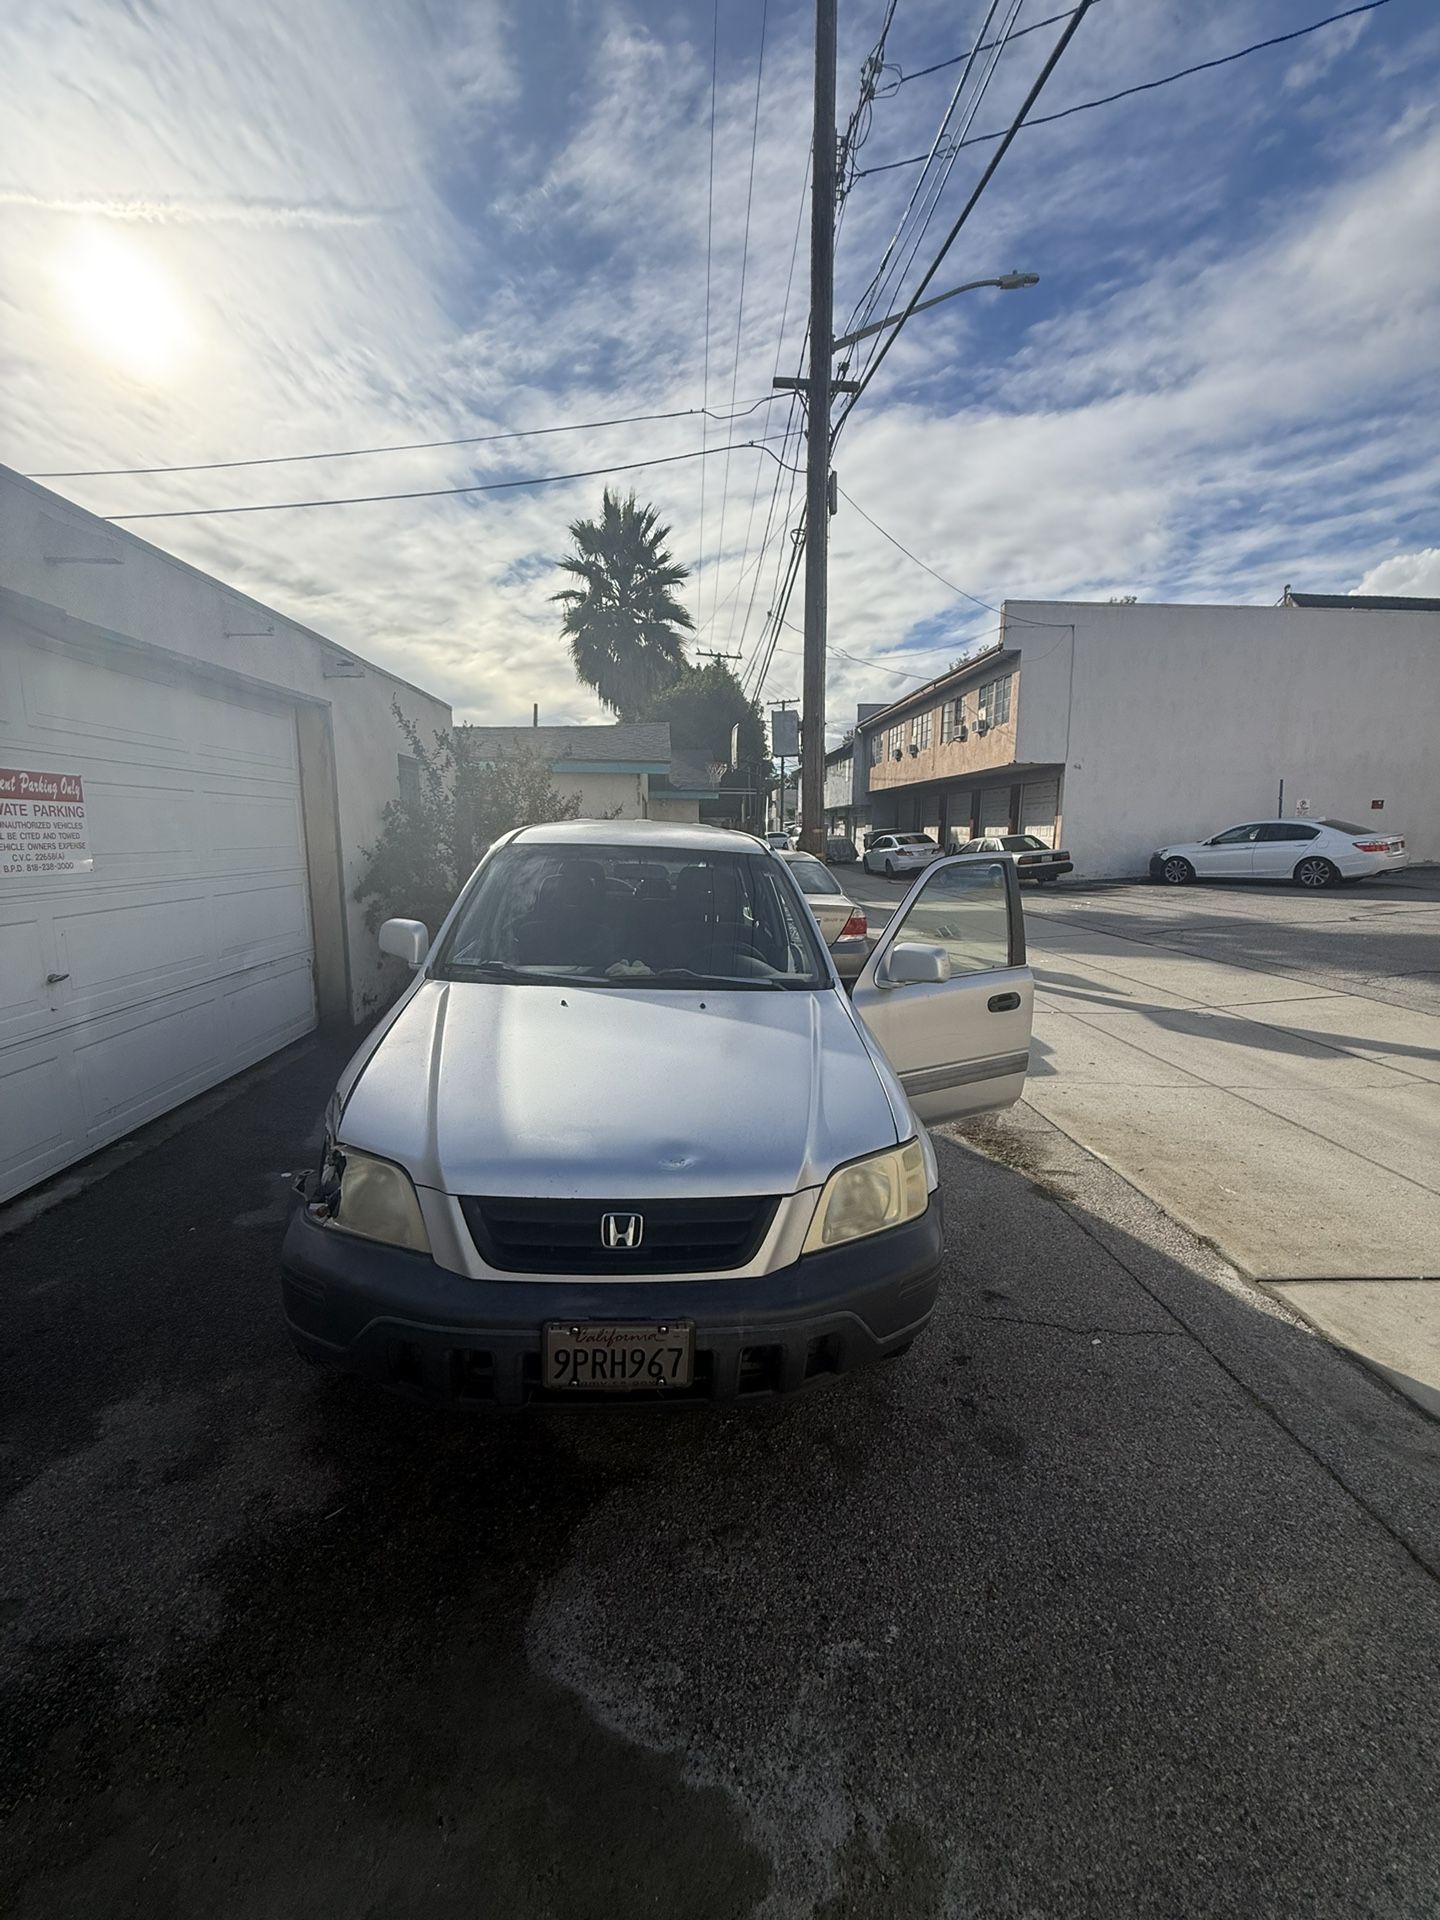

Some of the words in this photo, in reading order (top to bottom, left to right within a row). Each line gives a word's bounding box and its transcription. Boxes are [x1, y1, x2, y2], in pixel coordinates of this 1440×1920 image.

[19, 772, 58, 799] Parking
[60, 776, 80, 801] Only
[33, 804, 85, 818] PARKING
[0, 821, 51, 830] NAUTHORIZED
[53, 822, 83, 830] VEHICLES
[7, 832, 18, 840] BE
[19, 832, 41, 840] CITED
[43, 832, 57, 840] AND
[58, 832, 81, 840] TOWED
[27, 842, 57, 851] OWNERS
[58, 842, 86, 850] EXPENSE
[26, 862, 75, 873] 818-238-3000
[575, 1328, 665, 1347] California
[553, 1347, 684, 1380] 9PRH967
